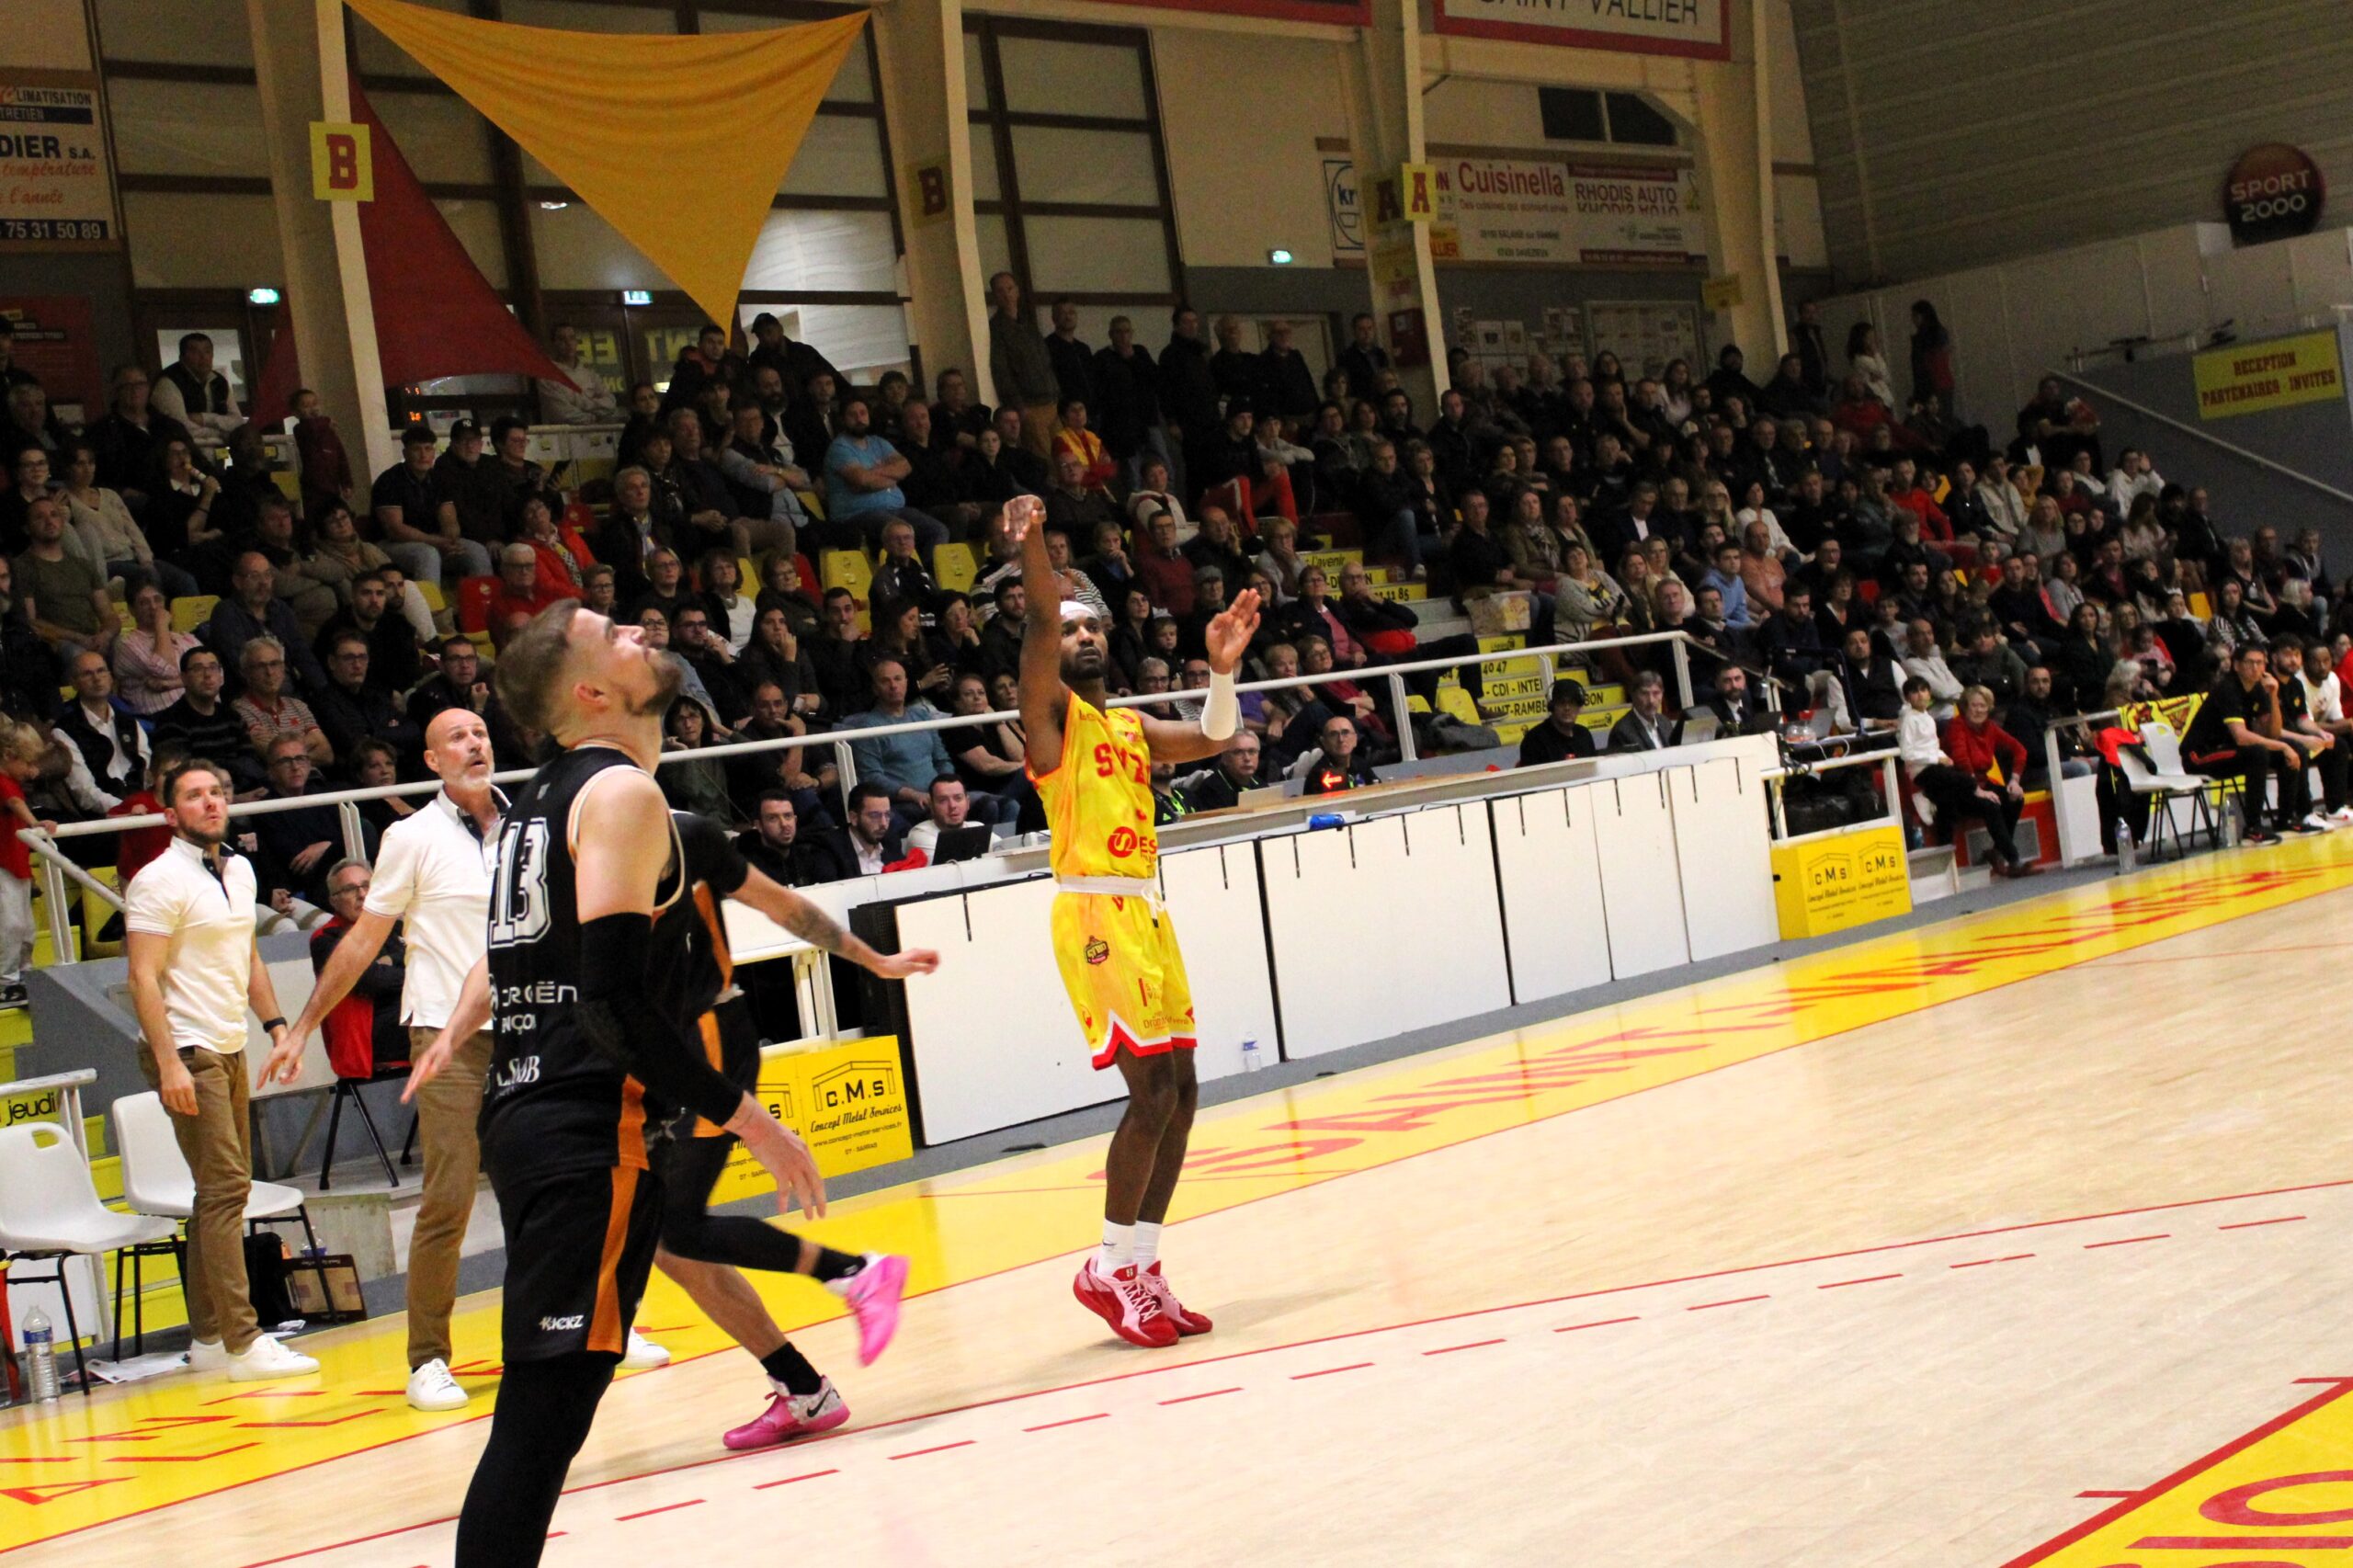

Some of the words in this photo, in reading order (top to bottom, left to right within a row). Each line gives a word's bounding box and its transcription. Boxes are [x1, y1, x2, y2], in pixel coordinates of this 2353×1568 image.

[325, 133, 358, 190] B
[918, 166, 947, 217] B
[1412, 172, 1430, 213] A
[1458, 161, 1564, 198] Cuisinella
[1574, 183, 1633, 202] RHODIS
[1638, 187, 1677, 204] AUTO
[2230, 169, 2311, 201] SPORT
[1377, 179, 1401, 222] A
[2241, 194, 2306, 222] 2000
[6, 222, 27, 239] 75
[31, 222, 51, 239] 31
[56, 222, 76, 239] 50
[2234, 351, 2296, 377] RECEPTION
[2202, 379, 2280, 406] PARTENAIRES
[2289, 369, 2336, 392] INVITES
[1496, 661, 1507, 674] 47
[1493, 684, 1509, 697] CDI
[489, 816, 551, 949] 13
[6, 1092, 56, 1126] jeudi
[811, 1115, 841, 1132] Concept
[843, 1108, 868, 1126] Metal
[870, 1103, 903, 1119] Services
